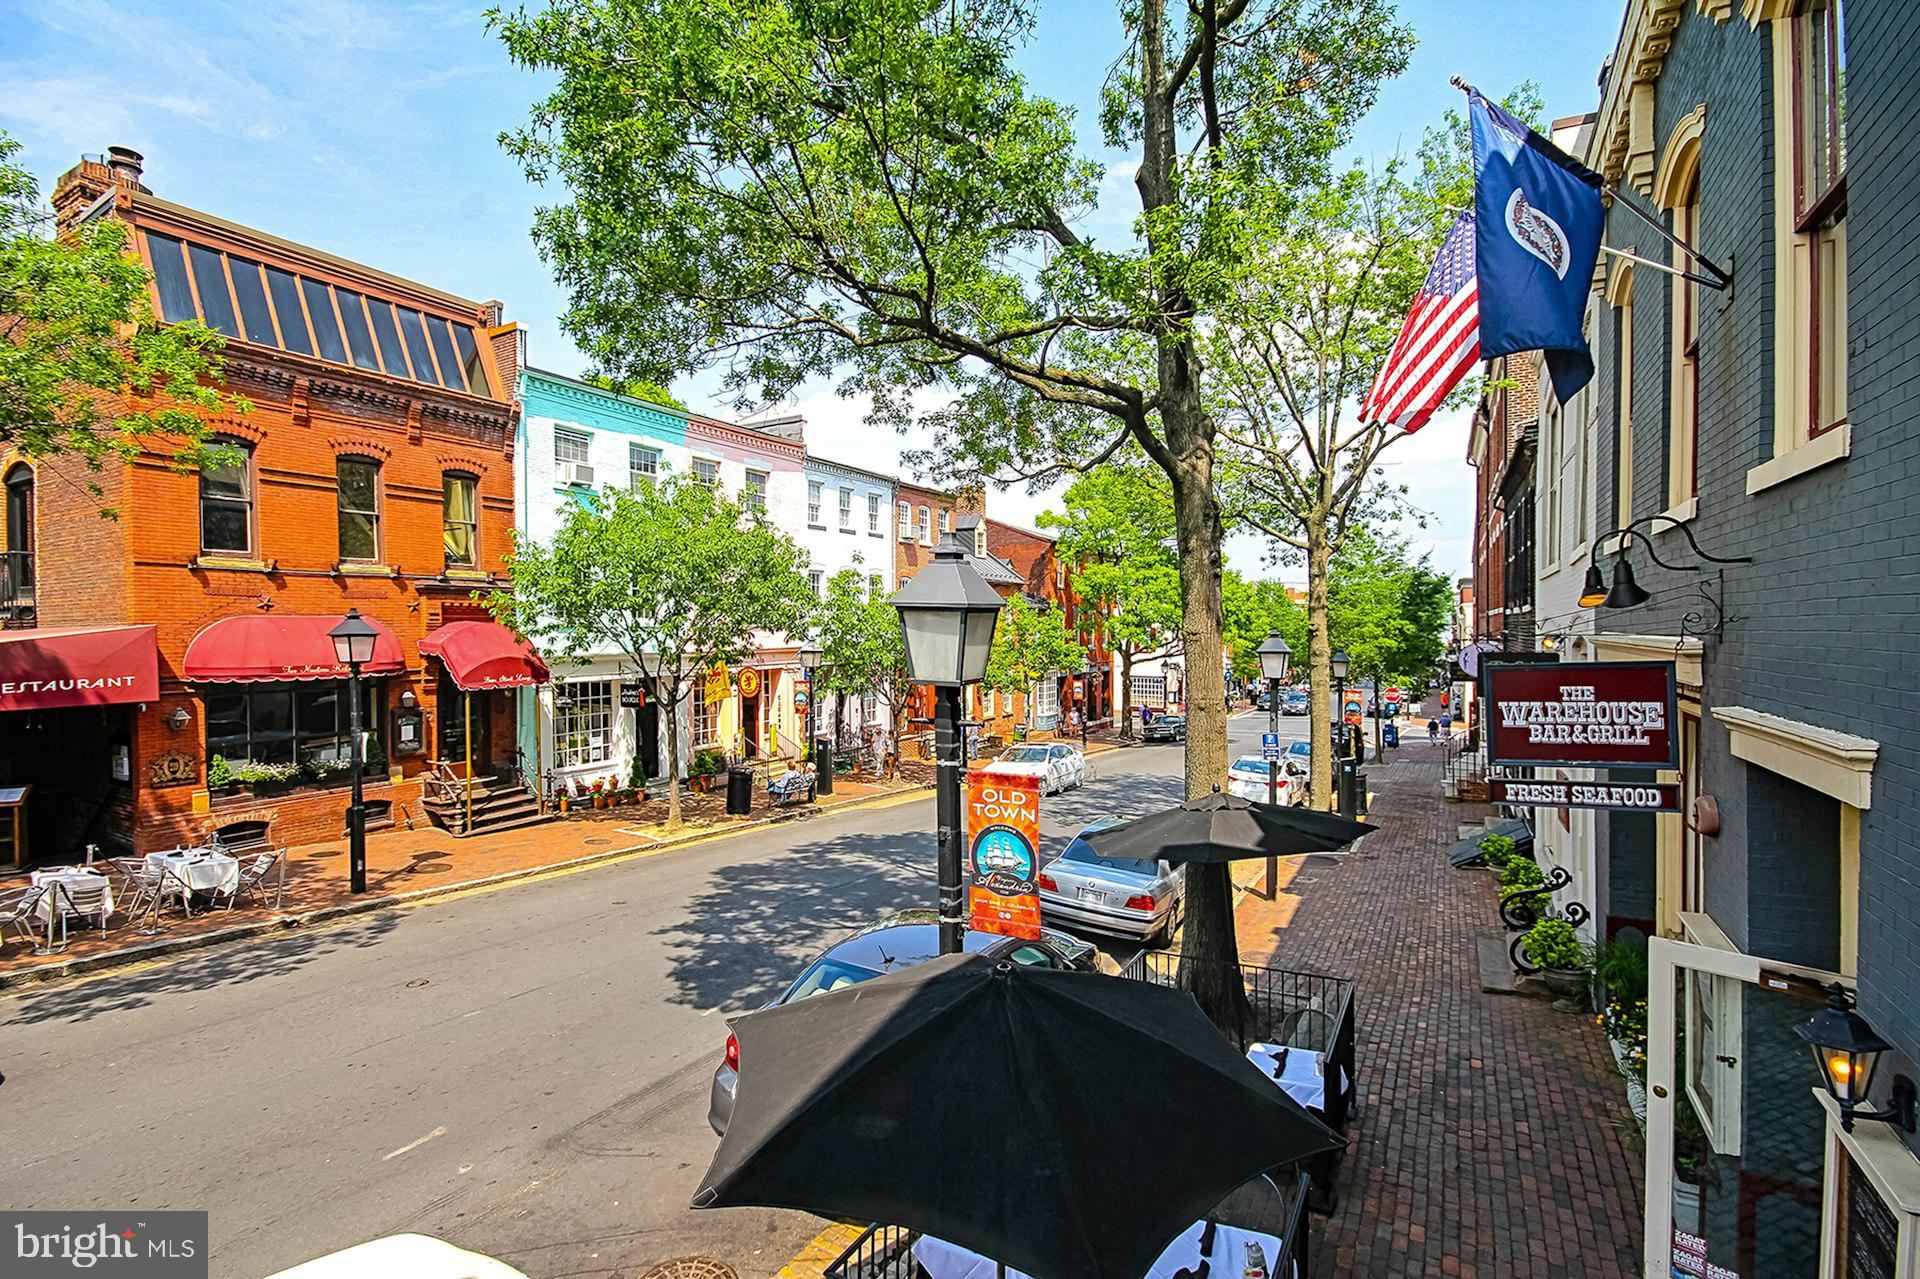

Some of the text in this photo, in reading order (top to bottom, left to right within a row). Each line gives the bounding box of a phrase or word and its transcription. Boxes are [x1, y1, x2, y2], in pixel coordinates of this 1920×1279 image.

[0, 676, 136, 695] ESTAURANT
[1559, 686, 1595, 702] THE
[1498, 701, 1665, 730] WAREHOUSE
[981, 788, 1027, 805] OLD
[1505, 783, 1662, 807] FRESH SEAFOOD
[972, 802, 1036, 823] TOWN
[1675, 1230, 1706, 1245] ZAGAT
[1675, 1236, 1705, 1252] RATED
[1672, 1248, 1704, 1265] ZAGAT
[1672, 1254, 1704, 1273] RATED
[1706, 1263, 1740, 1278] ZAGAT
